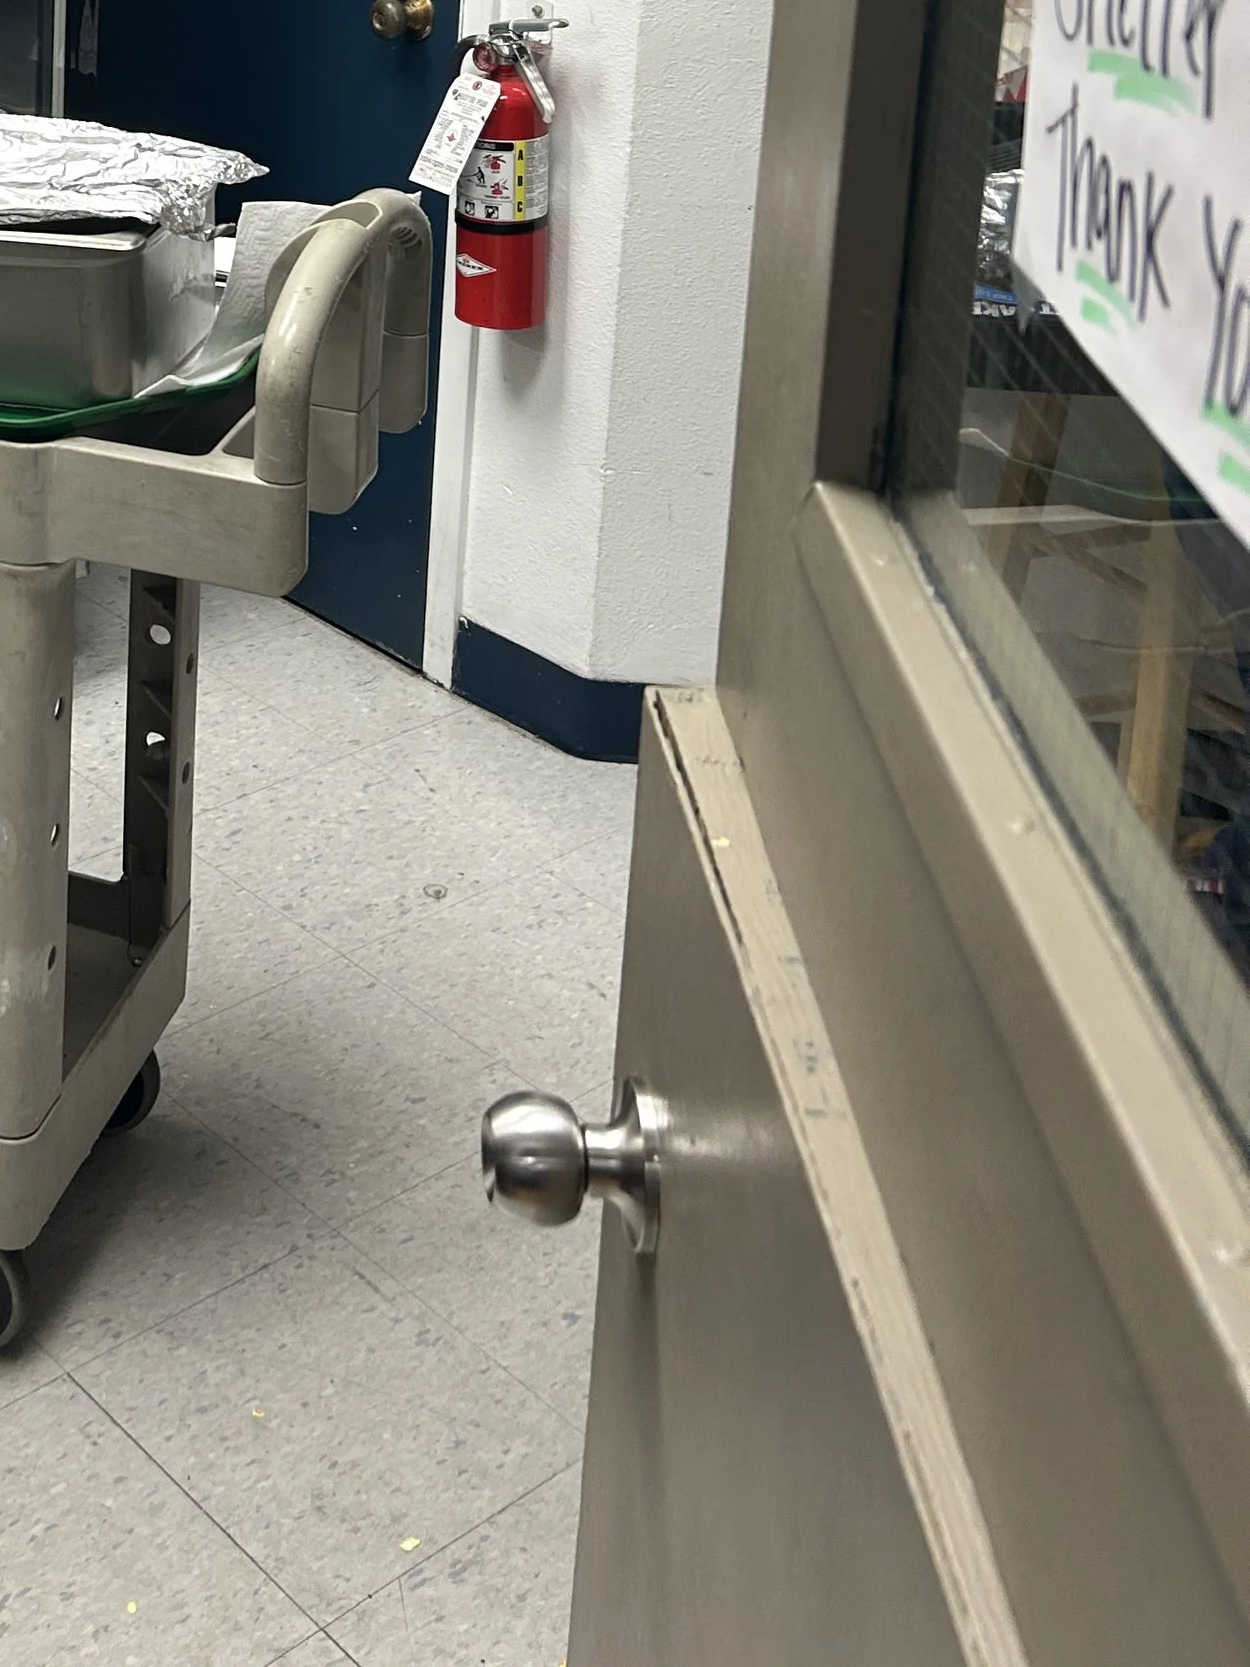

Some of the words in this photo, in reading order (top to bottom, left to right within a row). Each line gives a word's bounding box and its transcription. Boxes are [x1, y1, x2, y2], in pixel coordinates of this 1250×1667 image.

[517, 149, 524, 161] A
[517, 175, 523, 187] B
[517, 201, 523, 213] C
